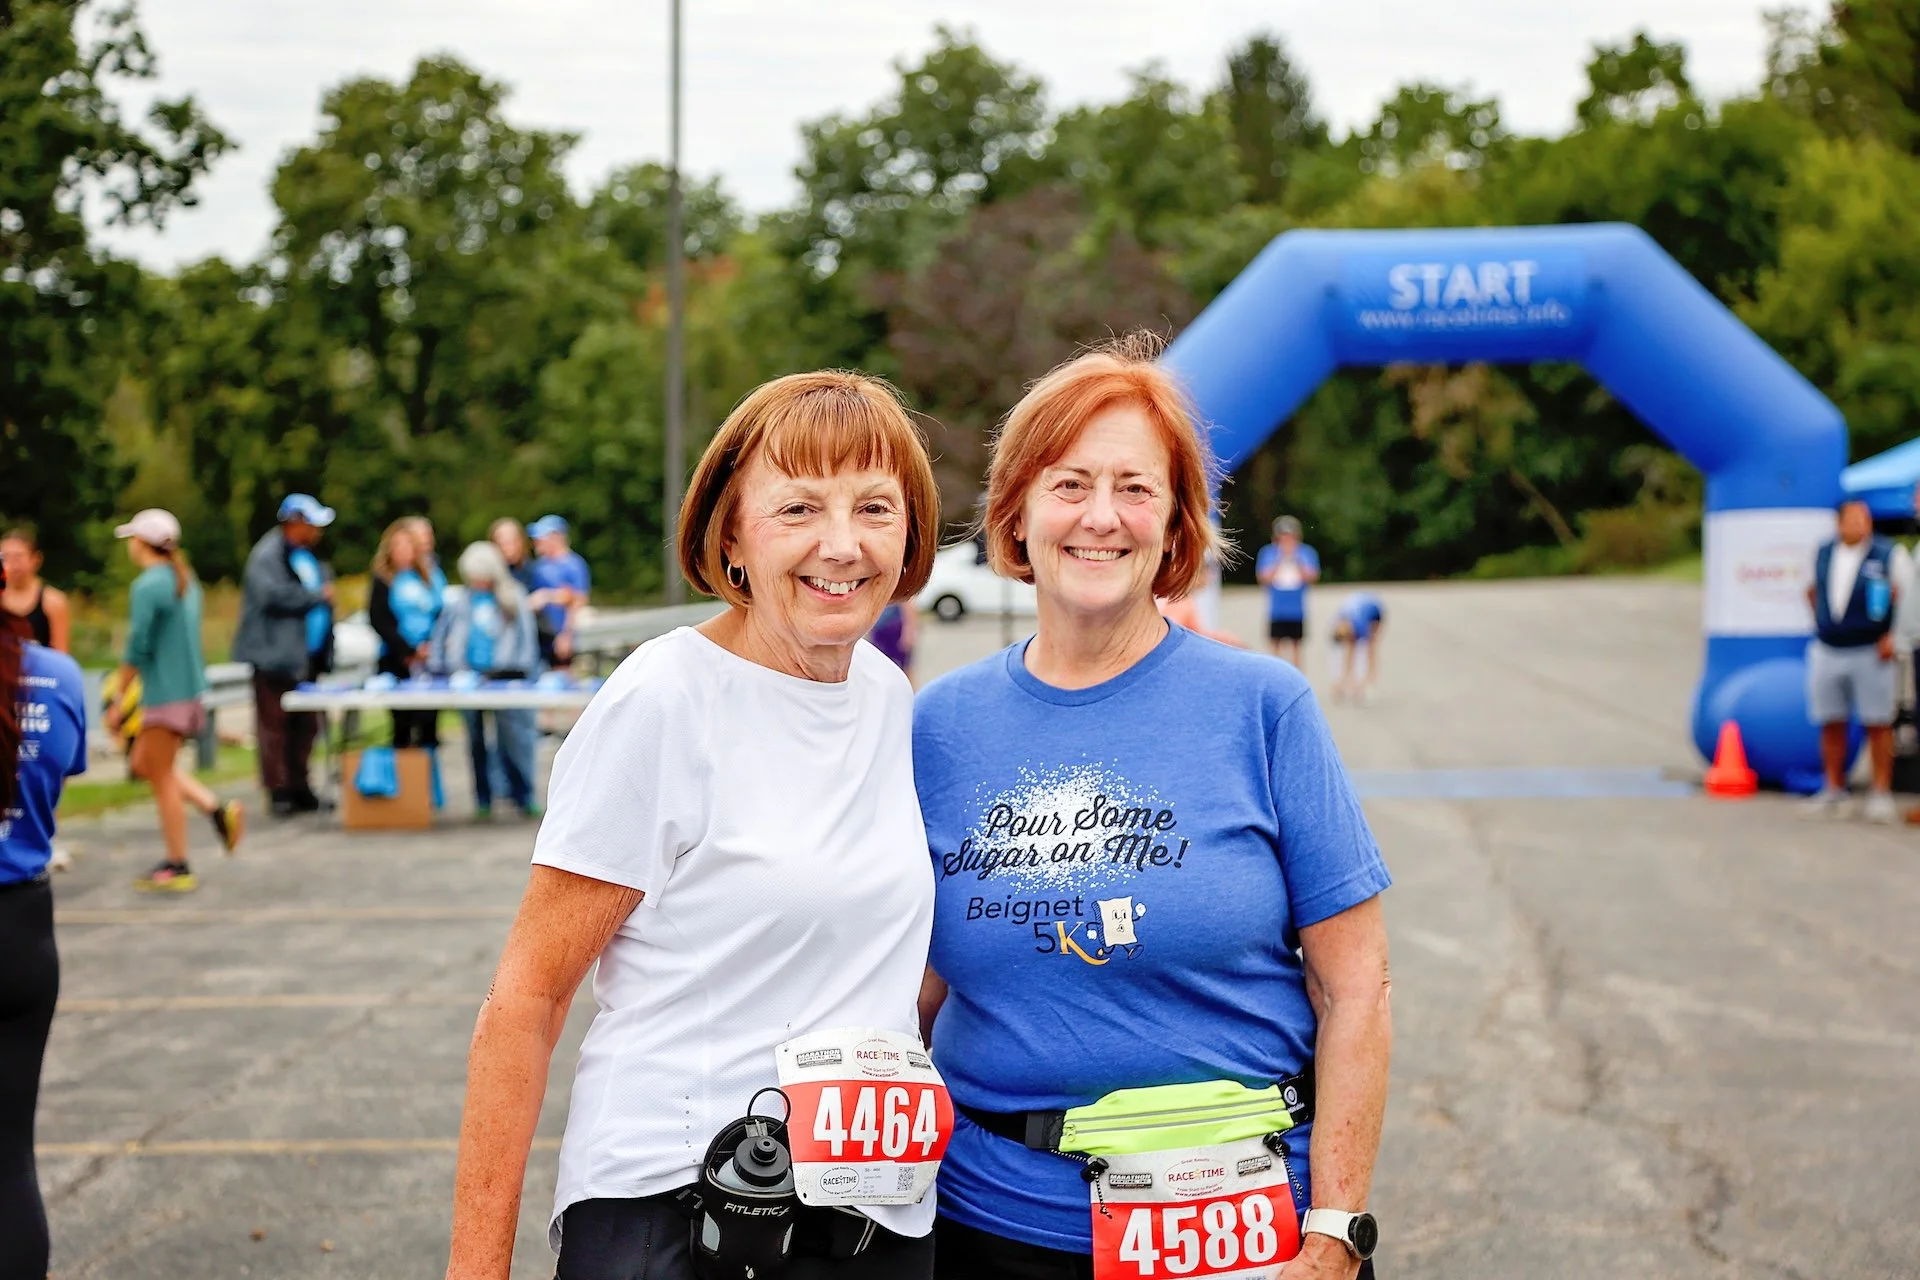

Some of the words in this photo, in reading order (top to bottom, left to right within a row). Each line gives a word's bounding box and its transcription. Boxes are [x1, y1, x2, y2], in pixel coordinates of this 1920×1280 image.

[1389, 260, 1537, 309] START
[987, 803, 1067, 838] Pour
[1072, 795, 1177, 836] Some
[941, 838, 1048, 881] Sugar
[1050, 843, 1096, 863] on
[1104, 833, 1191, 873] Me!
[966, 894, 1084, 925] Beignet
[1034, 921, 1110, 965] 5K
[856, 1050, 878, 1060] RACE
[883, 1051, 900, 1061] TIME
[813, 1086, 939, 1157] 4464
[823, 1177, 839, 1185] RACE
[843, 1175, 857, 1184] TIME
[1168, 1171, 1194, 1182] RACE
[1201, 1167, 1225, 1178] TIME
[724, 1202, 782, 1216] FITLETIC
[1119, 1194, 1278, 1275] 4588
